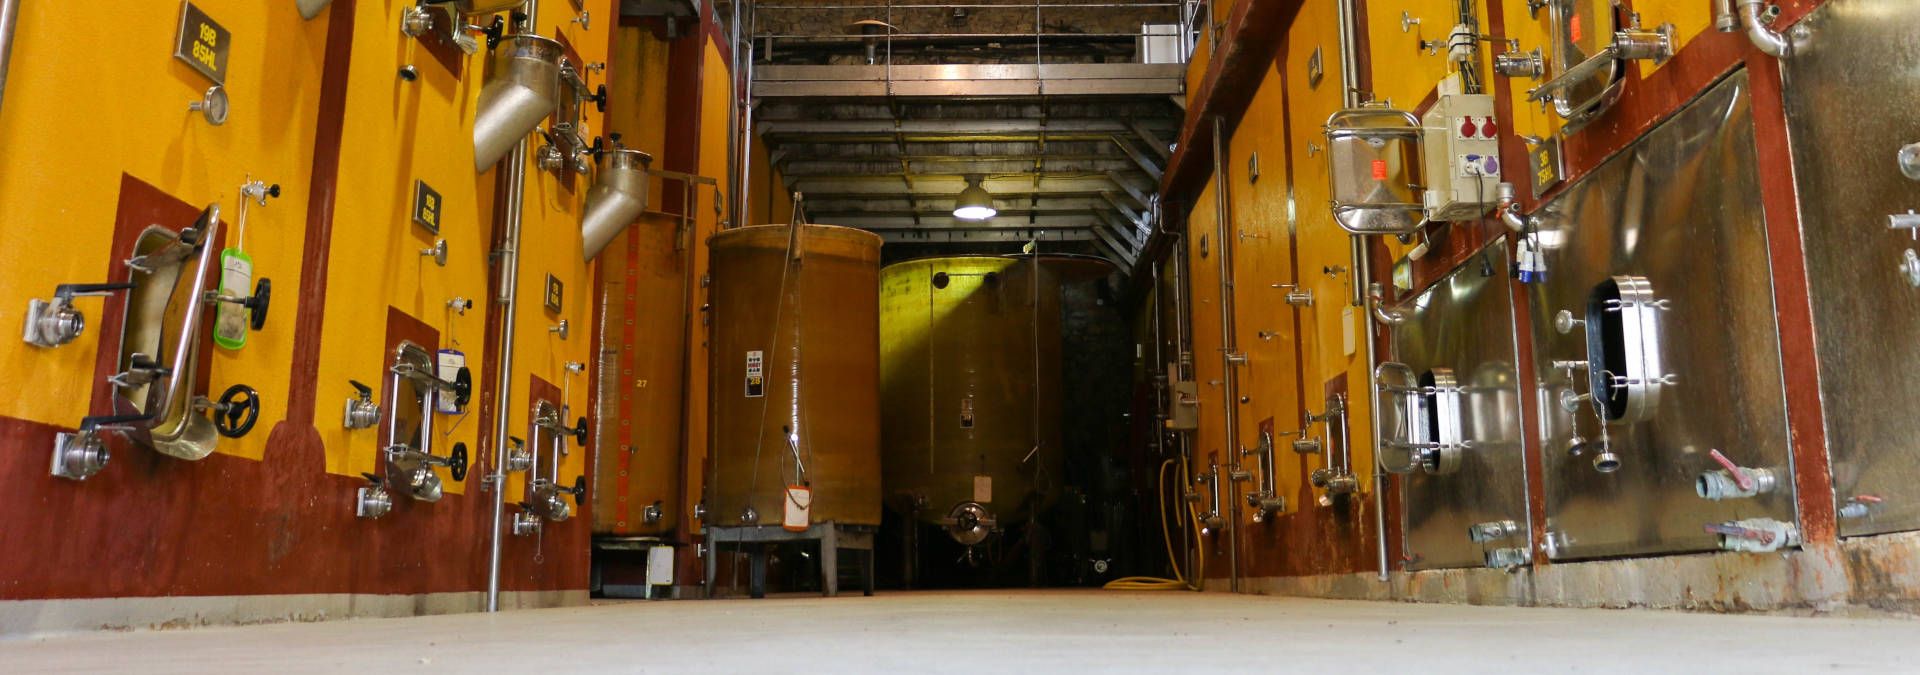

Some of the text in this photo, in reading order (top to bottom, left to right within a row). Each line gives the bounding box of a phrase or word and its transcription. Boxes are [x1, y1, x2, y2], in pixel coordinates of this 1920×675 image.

[200, 22, 216, 47] 19B
[192, 40, 217, 71] 85HL
[636, 379, 648, 388] 27
[751, 376, 761, 385] 28
